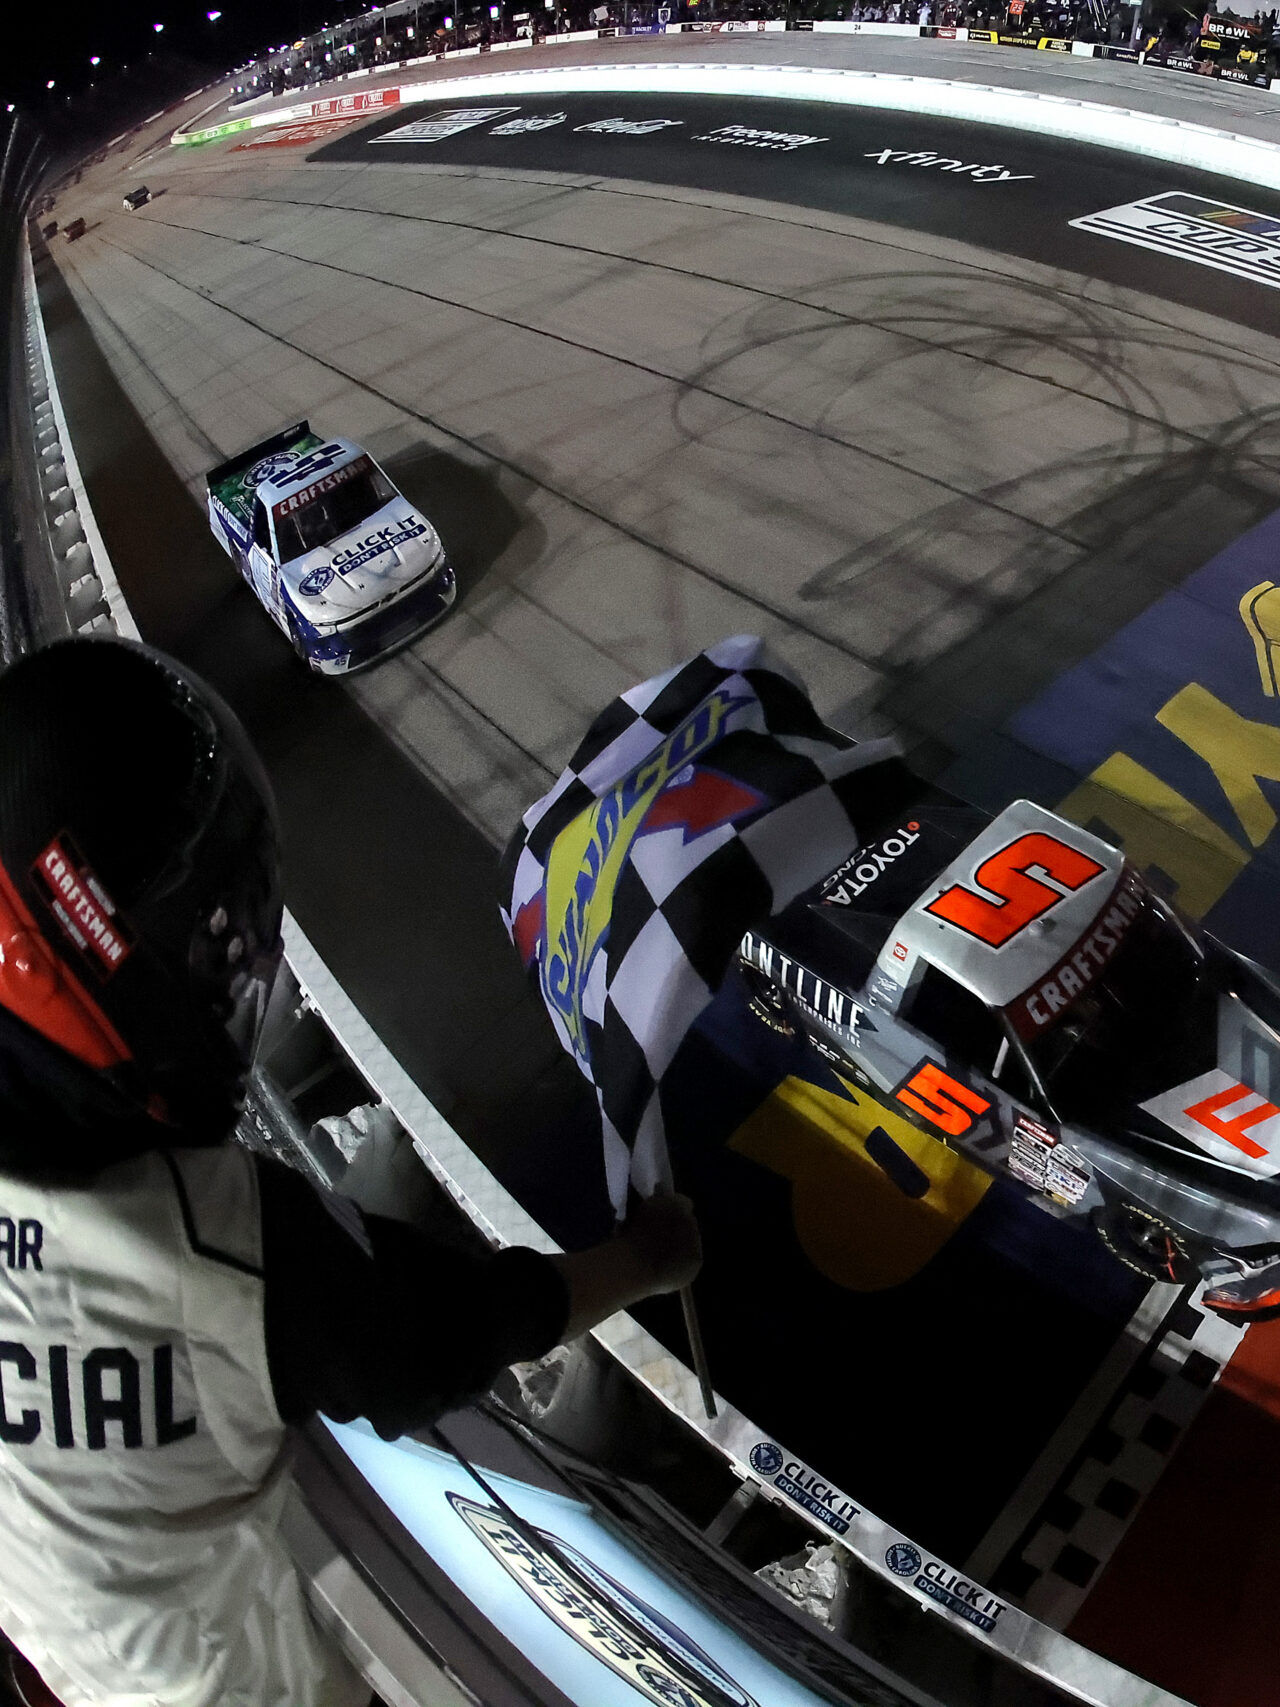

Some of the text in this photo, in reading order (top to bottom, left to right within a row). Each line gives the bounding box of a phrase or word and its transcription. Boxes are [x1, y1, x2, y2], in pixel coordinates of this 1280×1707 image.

[690, 134, 798, 151] INSURANCE
[709, 124, 830, 147] Freeway
[1145, 221, 1267, 253] CUP
[279, 456, 370, 516] CRAFTSMAN
[331, 514, 418, 566] CLICK IT
[343, 548, 379, 572] DON'T
[827, 828, 920, 905] TOYOTA
[922, 831, 1108, 949] 5
[45, 850, 123, 962] CRAFTSMAN
[1025, 880, 1149, 1026] CRAFTSMAN
[896, 1063, 991, 1136] 5
[778, 1478, 846, 1530] DON'T RISK IT
[784, 1462, 861, 1522] CLICK IT
[479, 1523, 630, 1661] CLICK IT
[924, 1562, 1007, 1619] CLICK IT
